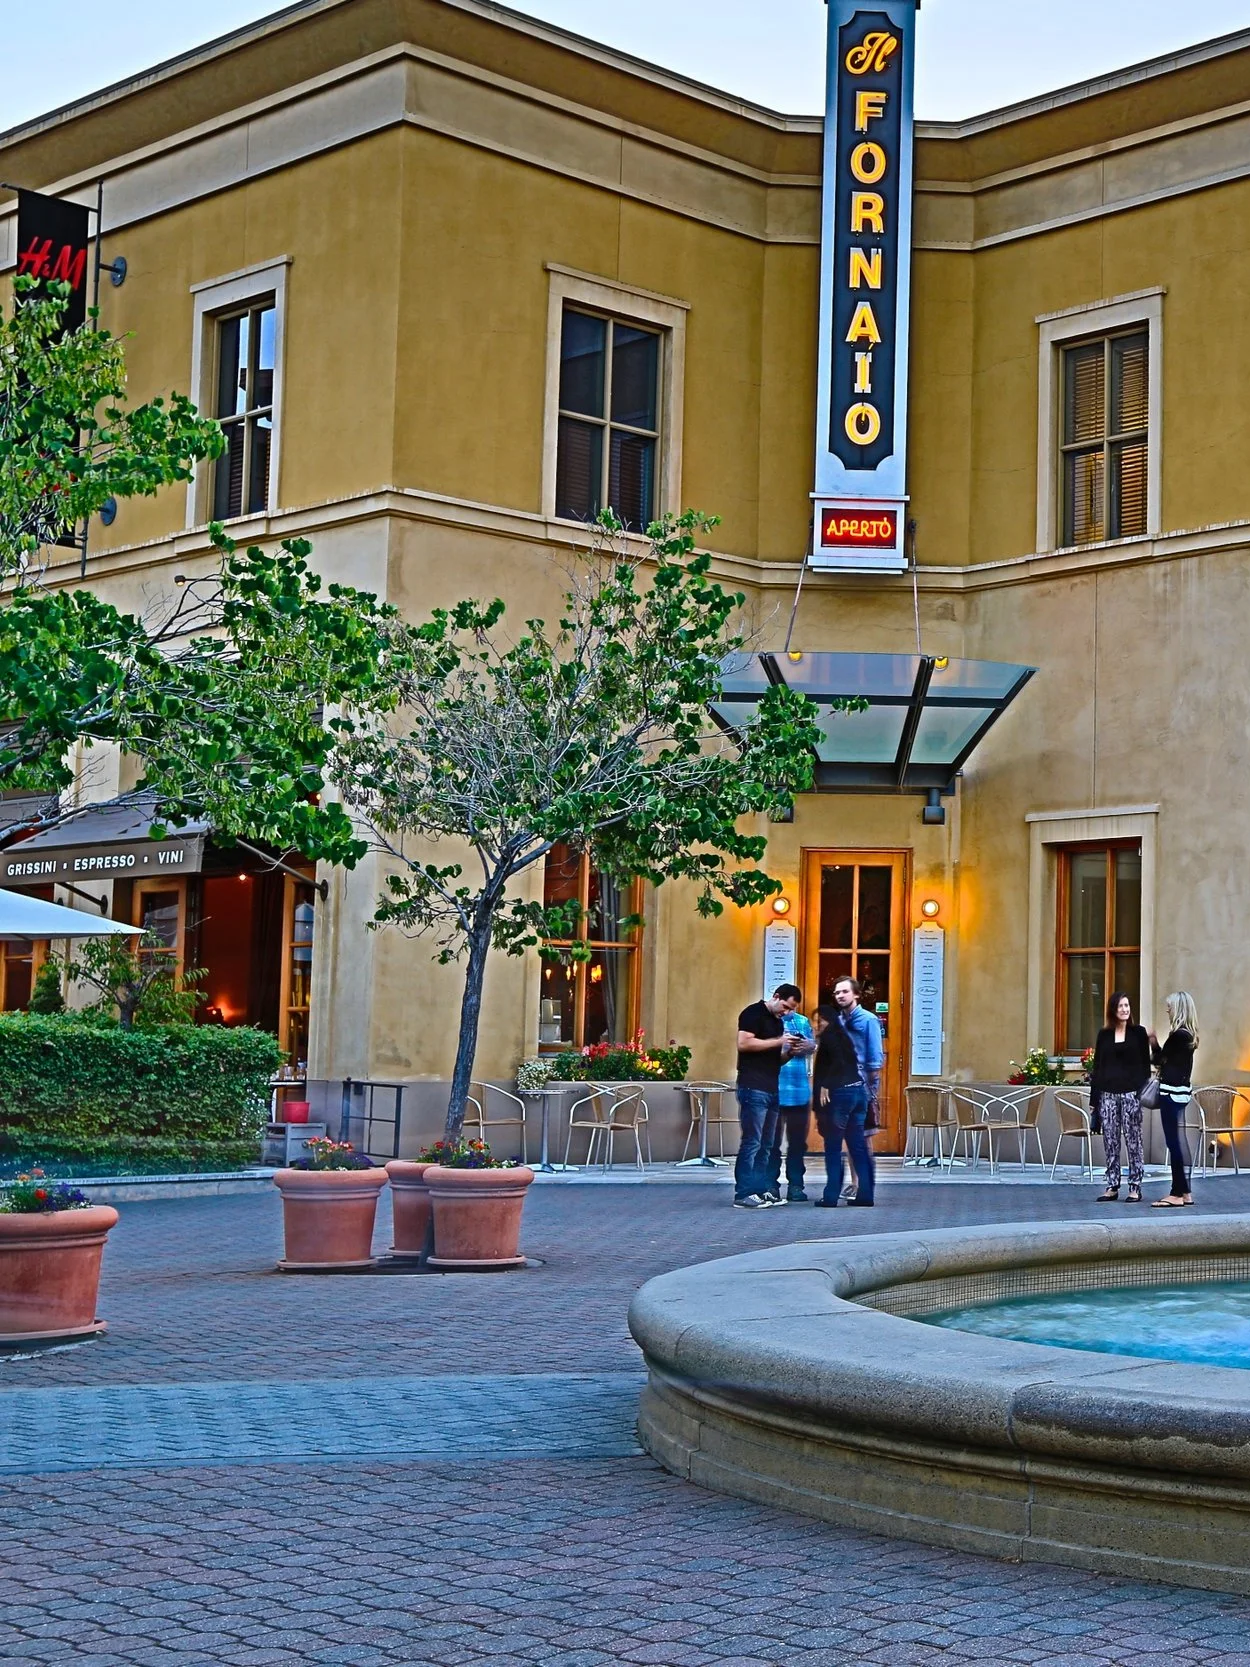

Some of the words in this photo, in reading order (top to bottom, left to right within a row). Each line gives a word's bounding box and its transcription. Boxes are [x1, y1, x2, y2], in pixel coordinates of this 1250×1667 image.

[17, 236, 87, 290] H&M
[843, 91, 888, 446] FORNAIO
[7, 860, 57, 876] GRISSINI
[73, 854, 136, 872] ESPRESSO
[158, 850, 184, 865] VINI
